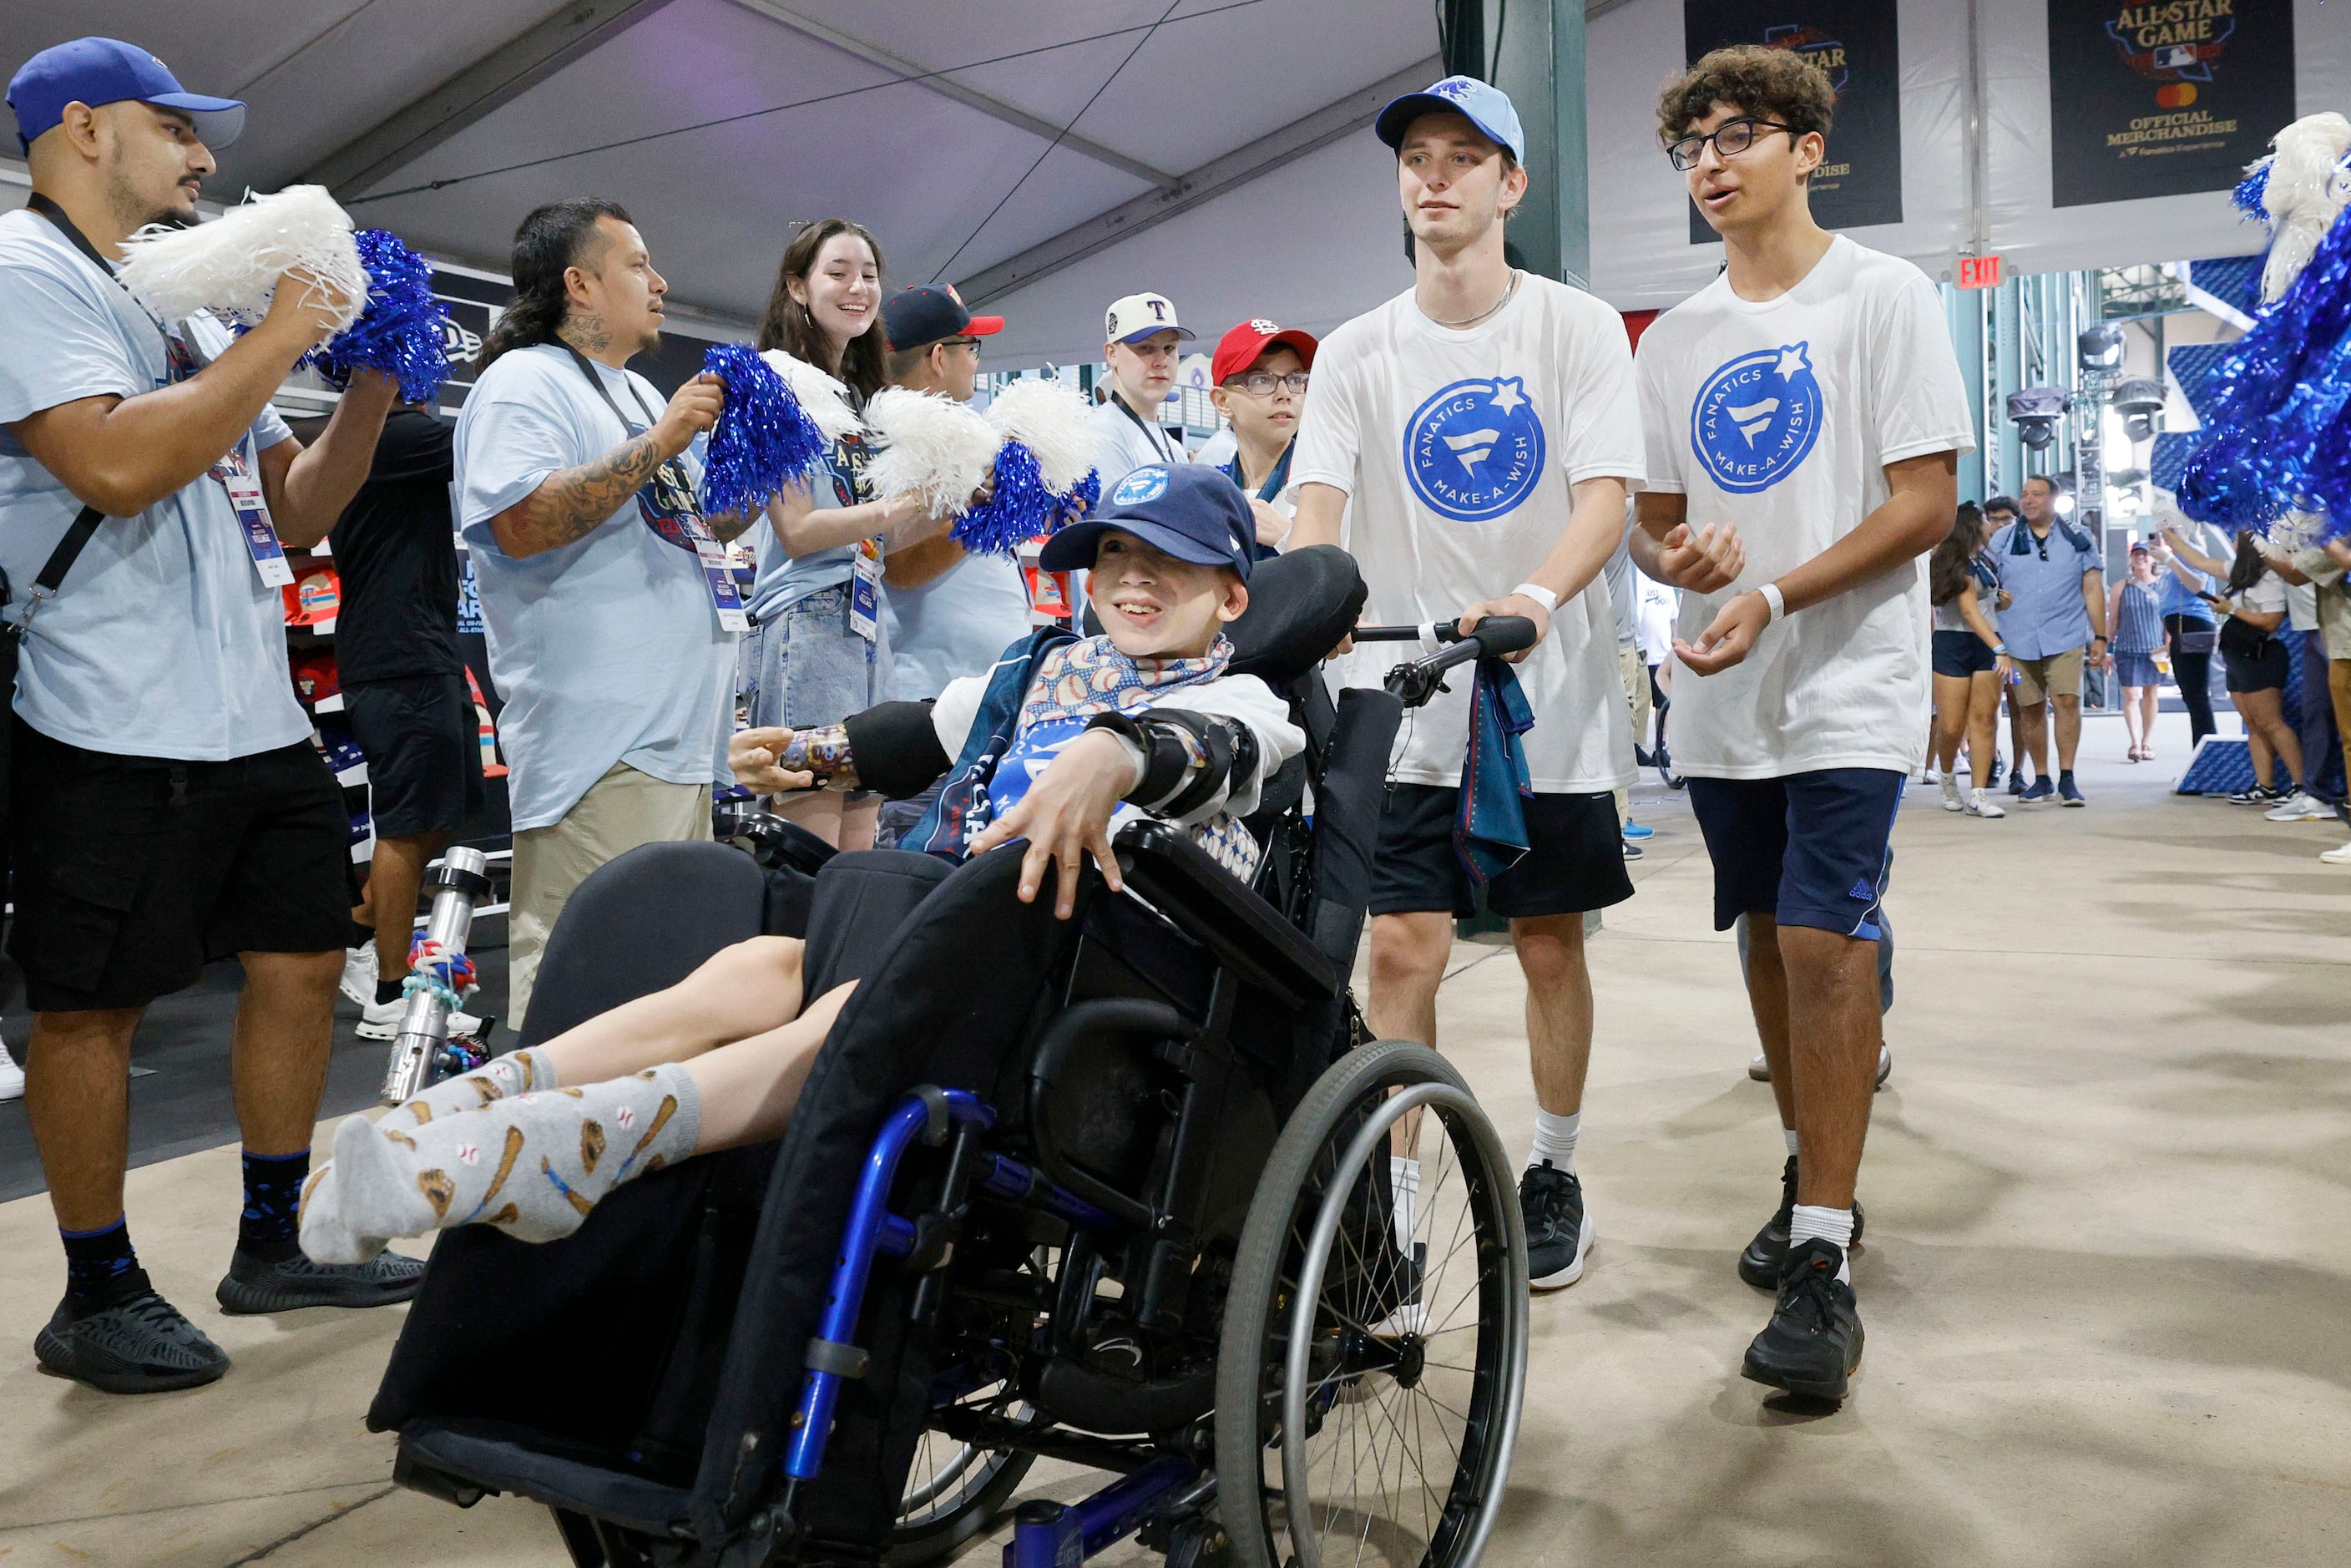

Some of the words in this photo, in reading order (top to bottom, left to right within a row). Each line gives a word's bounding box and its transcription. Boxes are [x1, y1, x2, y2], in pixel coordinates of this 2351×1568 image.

[2137, 19, 2212, 48] GAME
[2107, 119, 2237, 145] MERCHANDISE
[2131, 110, 2212, 130] OFFICIAL
[1960, 255, 2001, 289] EXIT
[1146, 301, 1166, 321] T
[1706, 369, 1762, 440] FANATICS
[1421, 398, 1475, 468] FANATICS
[1715, 402, 1804, 476] MAKE-A-WISH
[1433, 436, 1528, 504] MAKE-A-WISH
